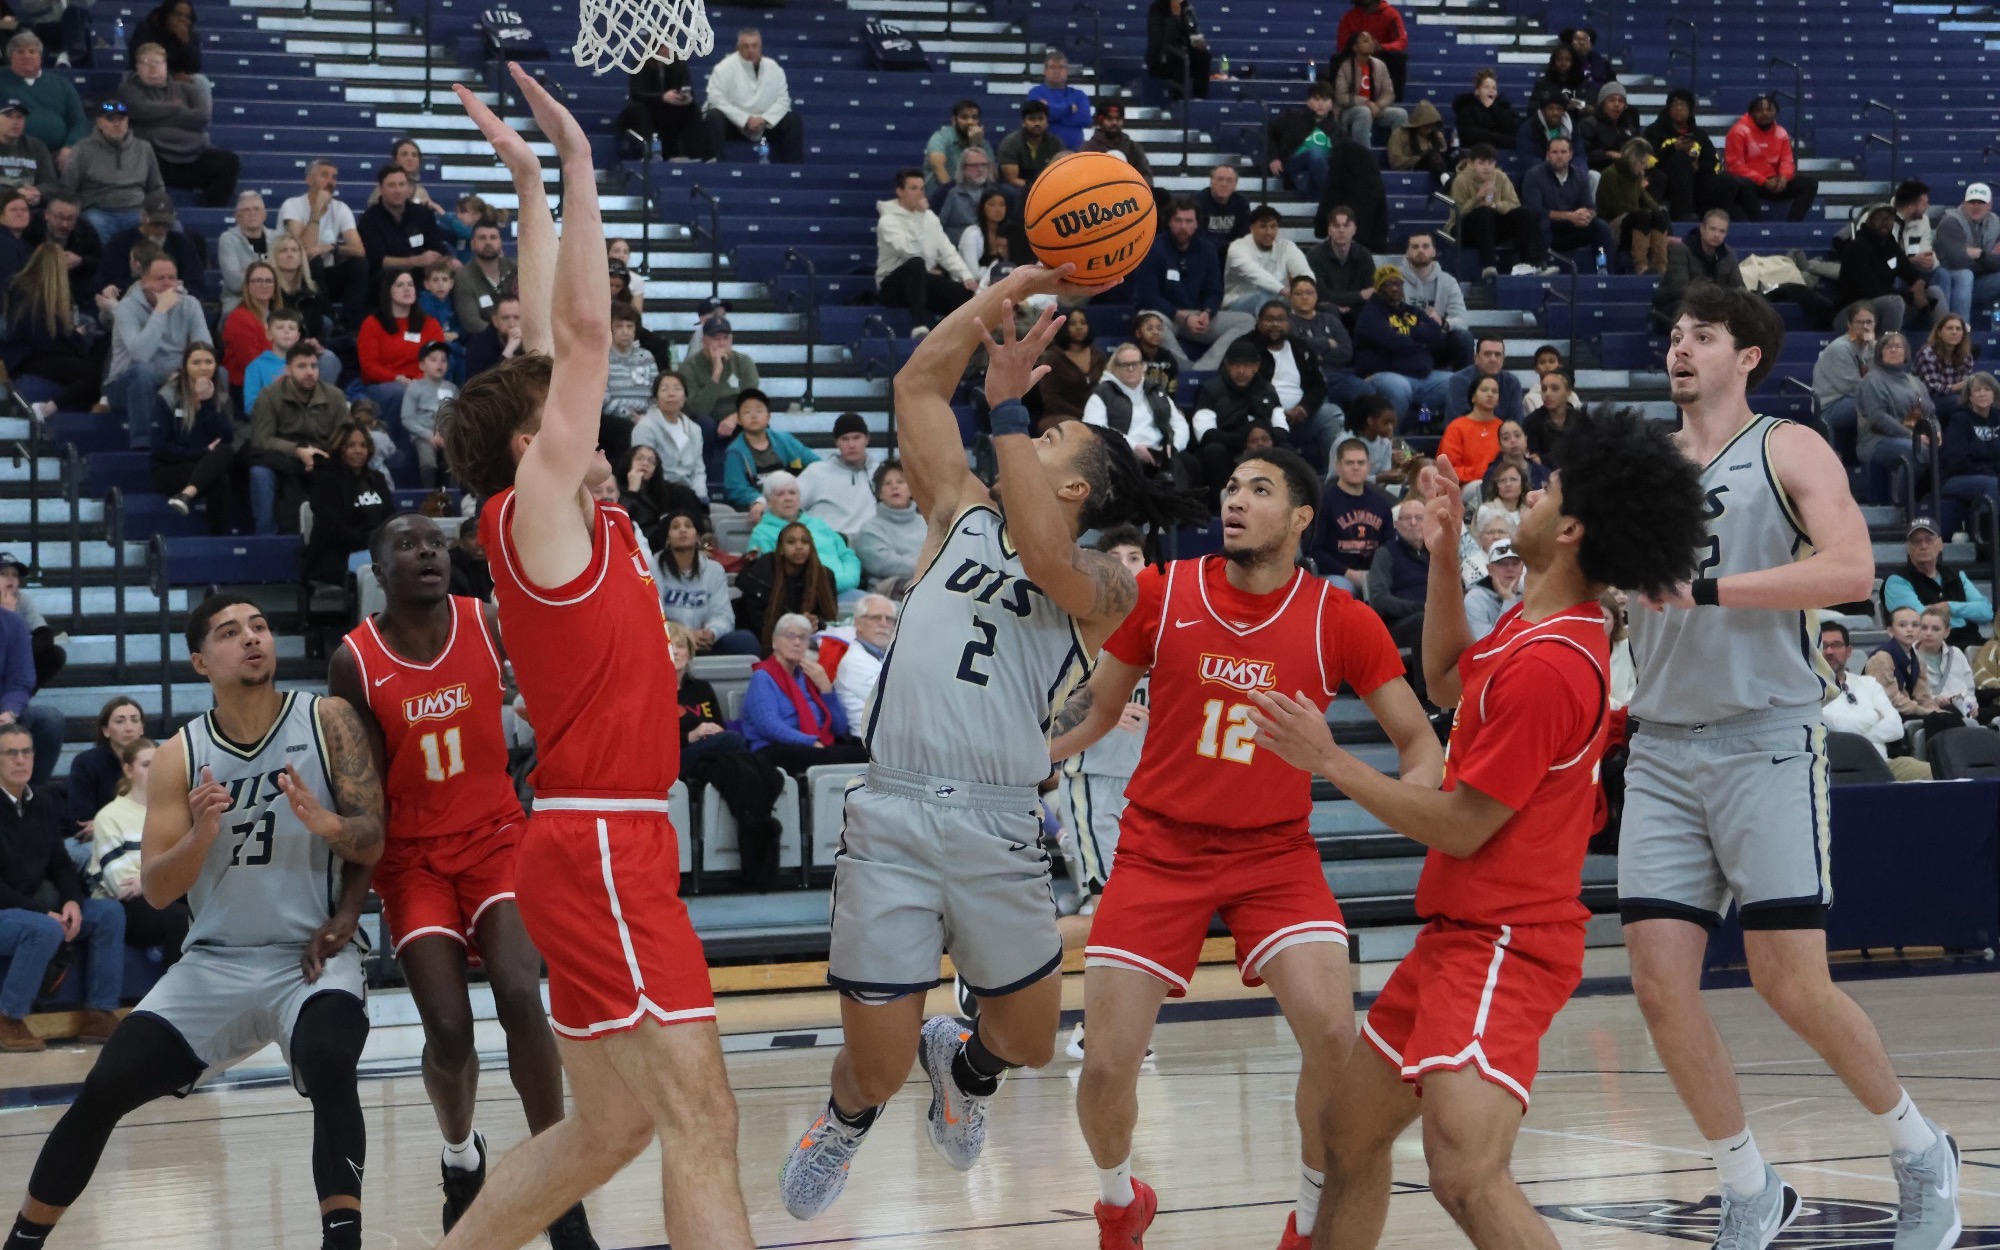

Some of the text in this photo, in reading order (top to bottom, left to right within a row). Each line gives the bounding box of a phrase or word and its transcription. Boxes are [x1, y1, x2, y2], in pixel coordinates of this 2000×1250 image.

[1051, 197, 1140, 238] Wilson
[945, 558, 1044, 618] UIS
[956, 614, 998, 687] 2
[1200, 655, 1274, 692] UMSL
[404, 685, 471, 724] UMSL
[1197, 699, 1257, 765] 12
[420, 727, 465, 782] 11
[230, 810, 276, 866] 23
